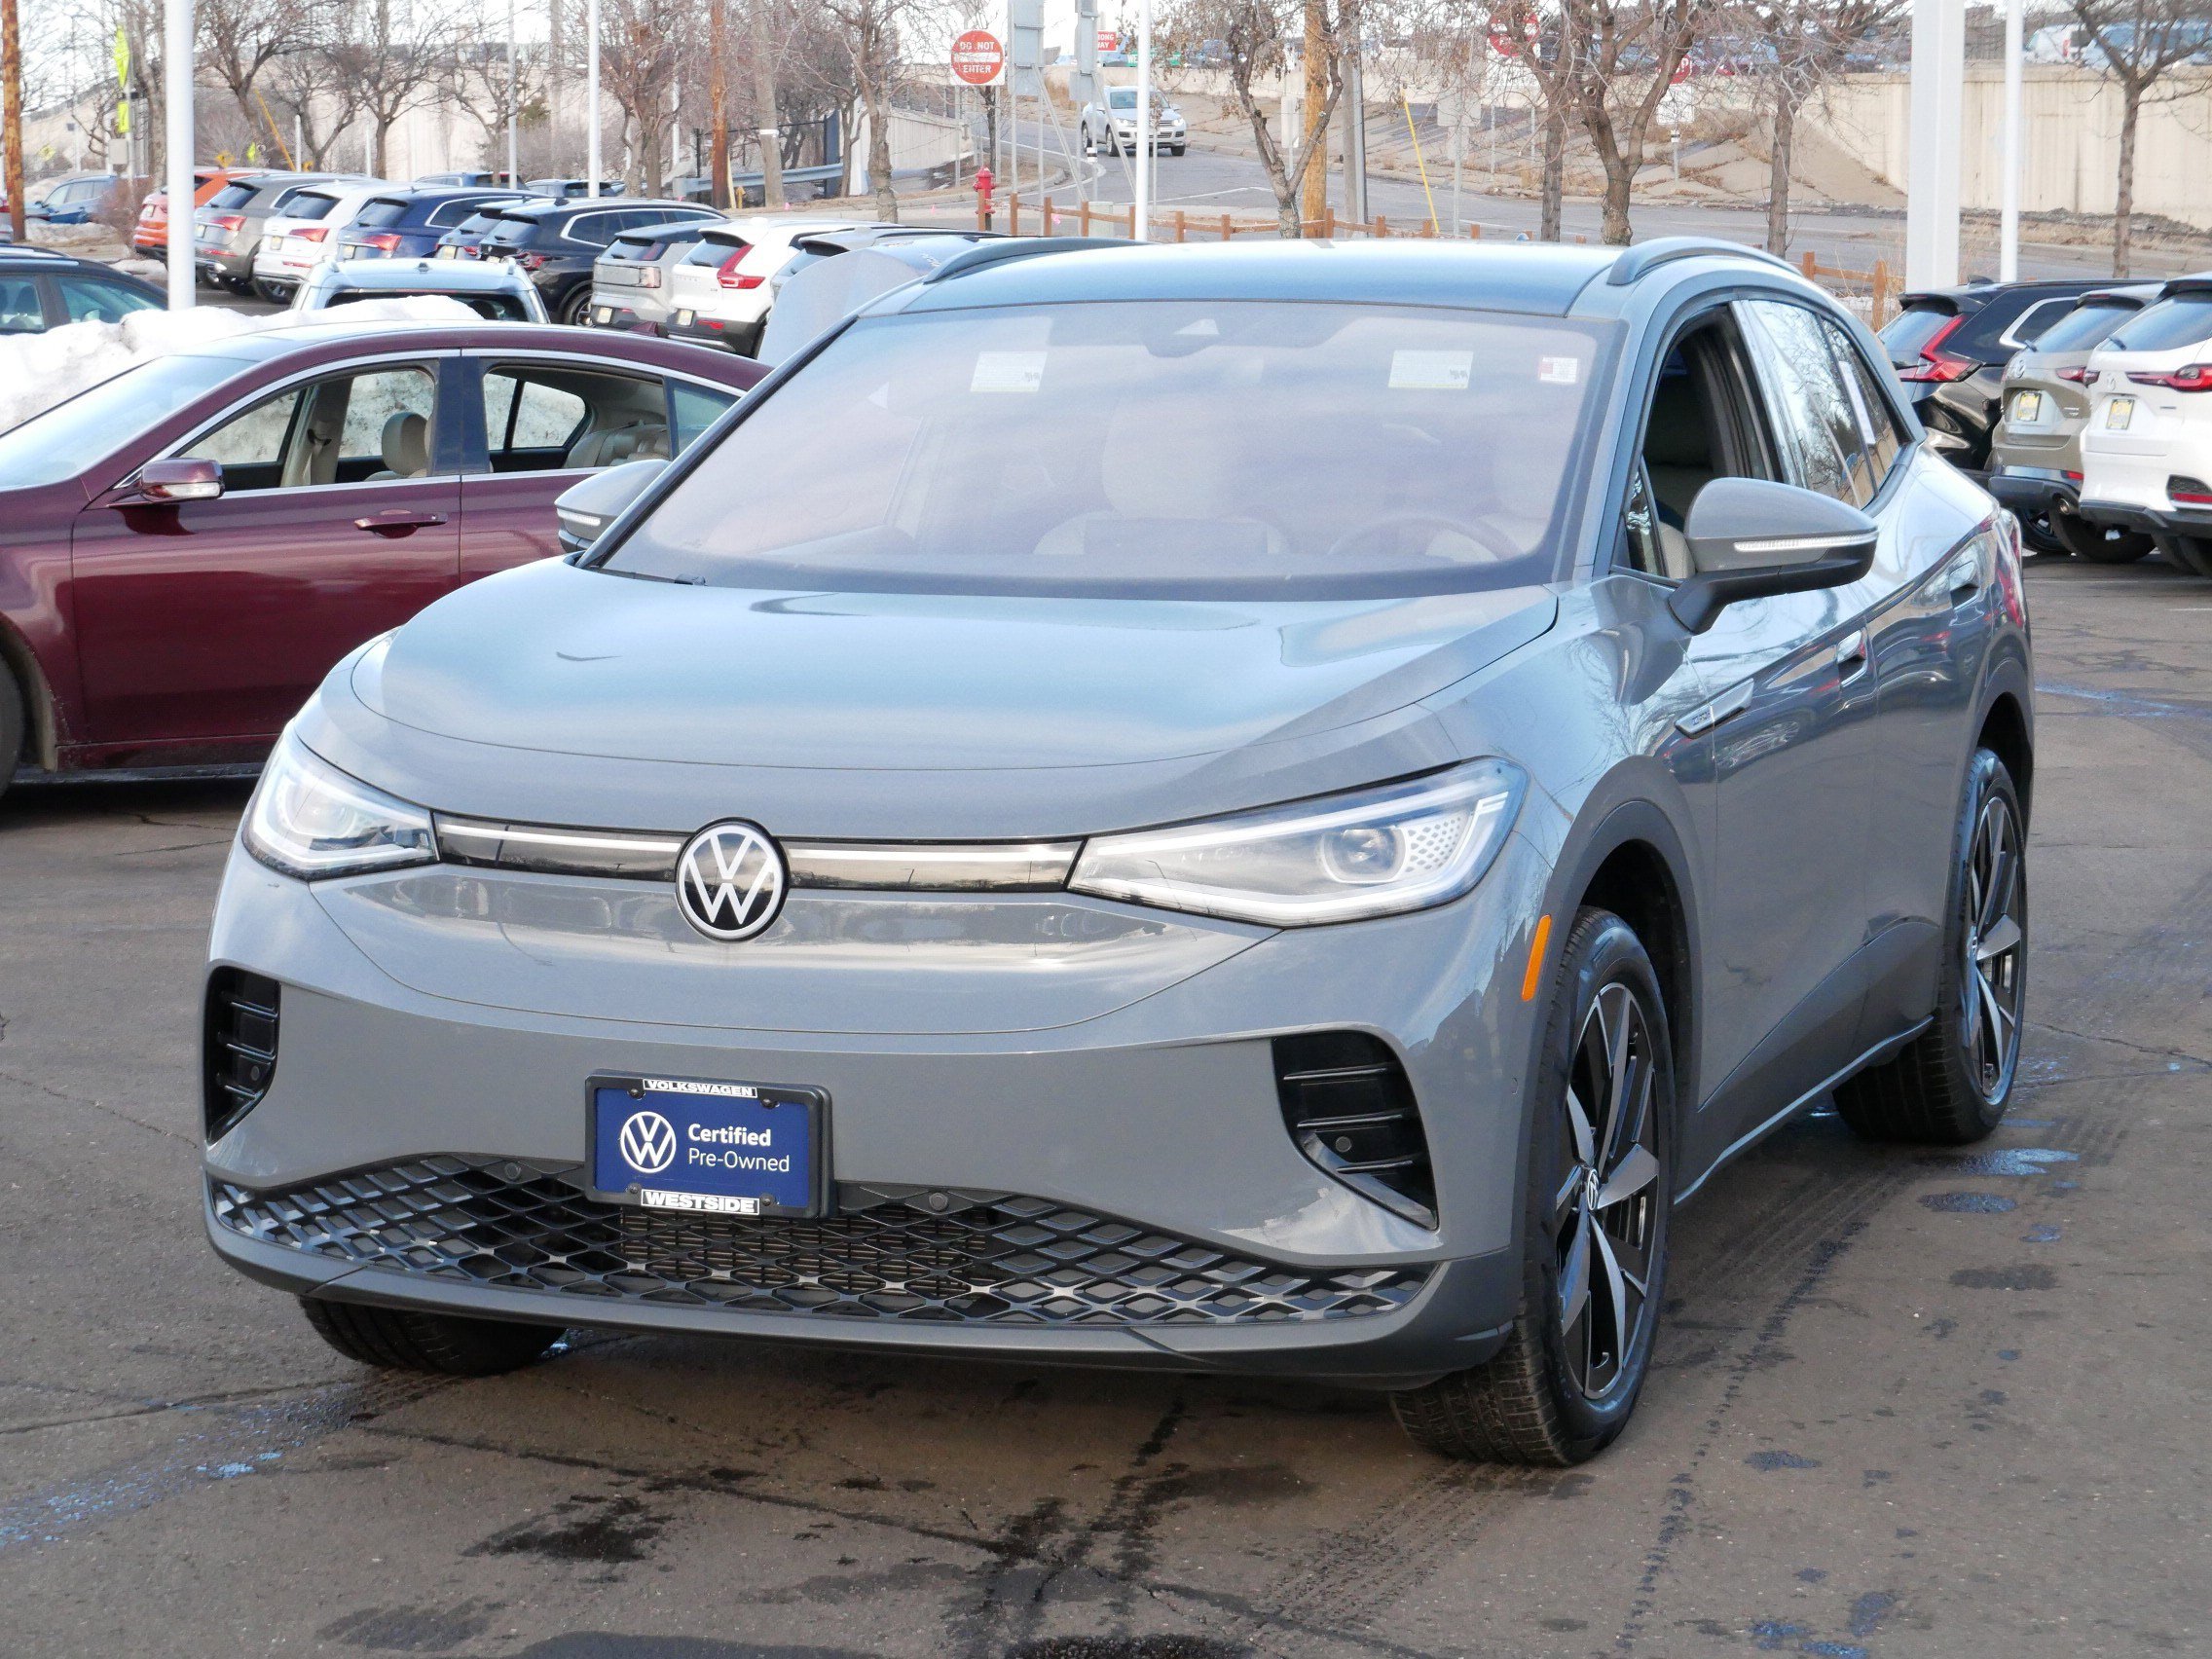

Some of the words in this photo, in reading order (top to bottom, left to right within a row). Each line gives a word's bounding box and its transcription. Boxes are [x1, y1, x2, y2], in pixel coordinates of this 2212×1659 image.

[963, 64, 992, 73] ENTER
[646, 1079, 754, 1097] VOLKSWAGEN
[620, 1111, 677, 1173] VW
[687, 1123, 772, 1147] Certified
[688, 1147, 791, 1172] Pre-Owned
[645, 1191, 756, 1214] WESTSIDE
